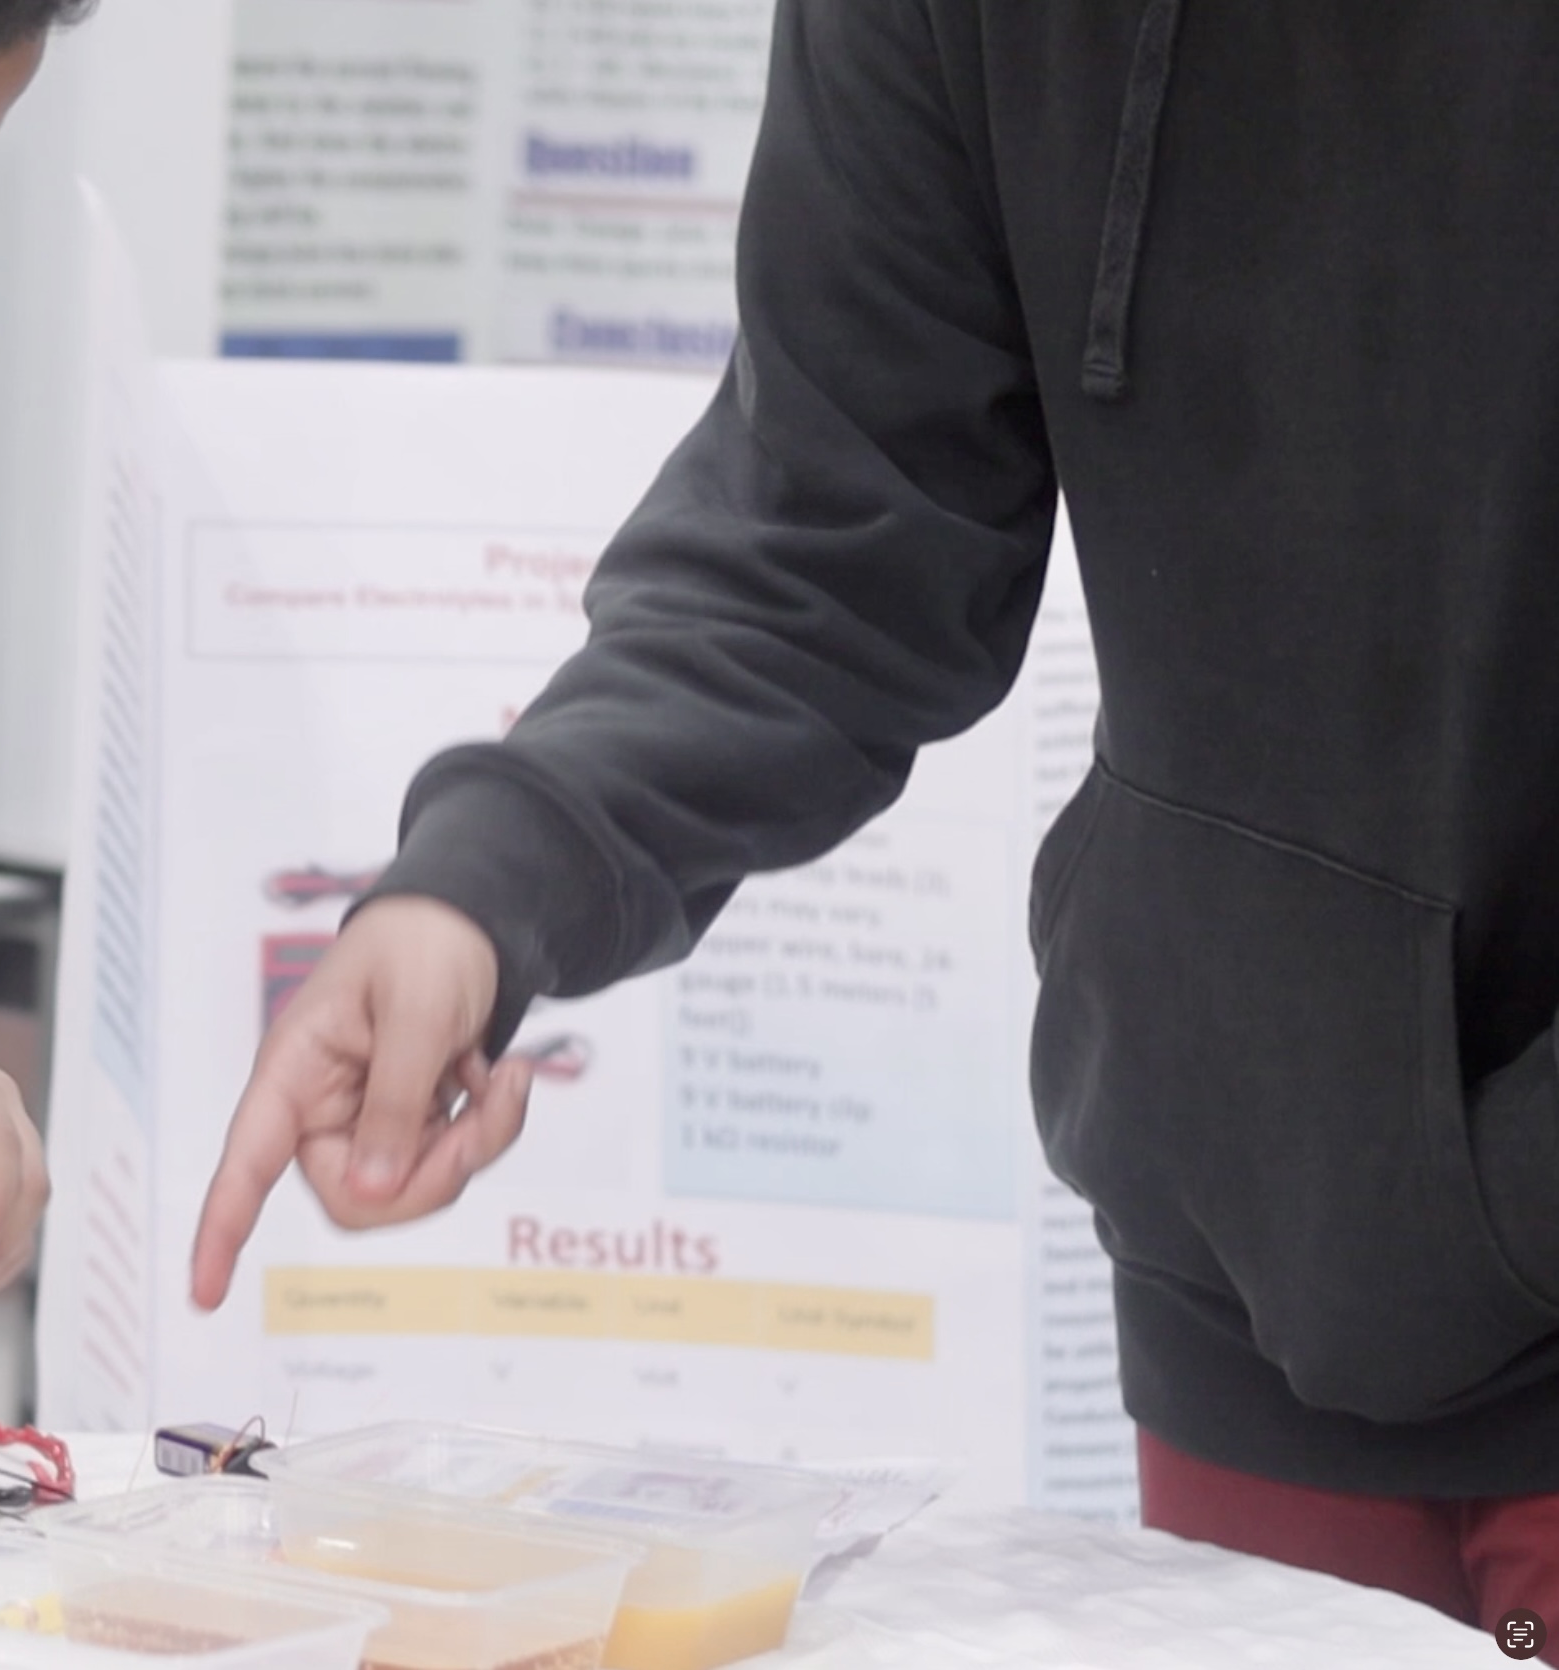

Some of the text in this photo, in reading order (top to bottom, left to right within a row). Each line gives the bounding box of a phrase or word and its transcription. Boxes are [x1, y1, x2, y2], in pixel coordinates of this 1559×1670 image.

[523, 127, 694, 179] Question
[552, 304, 734, 356] Conclusi
[484, 544, 591, 581] Proje
[222, 581, 344, 611] Compare
[356, 582, 511, 614] Electrolytes
[728, 1048, 823, 1083] battery
[727, 1088, 821, 1123] battery
[826, 1094, 875, 1126] clip
[746, 1129, 843, 1158] resistor
[508, 1213, 721, 1275] Results
[282, 1286, 388, 1315] Quantity
[490, 1286, 590, 1313] Variable
[833, 1305, 916, 1337] Symbol
[282, 1359, 377, 1388] Voltage
